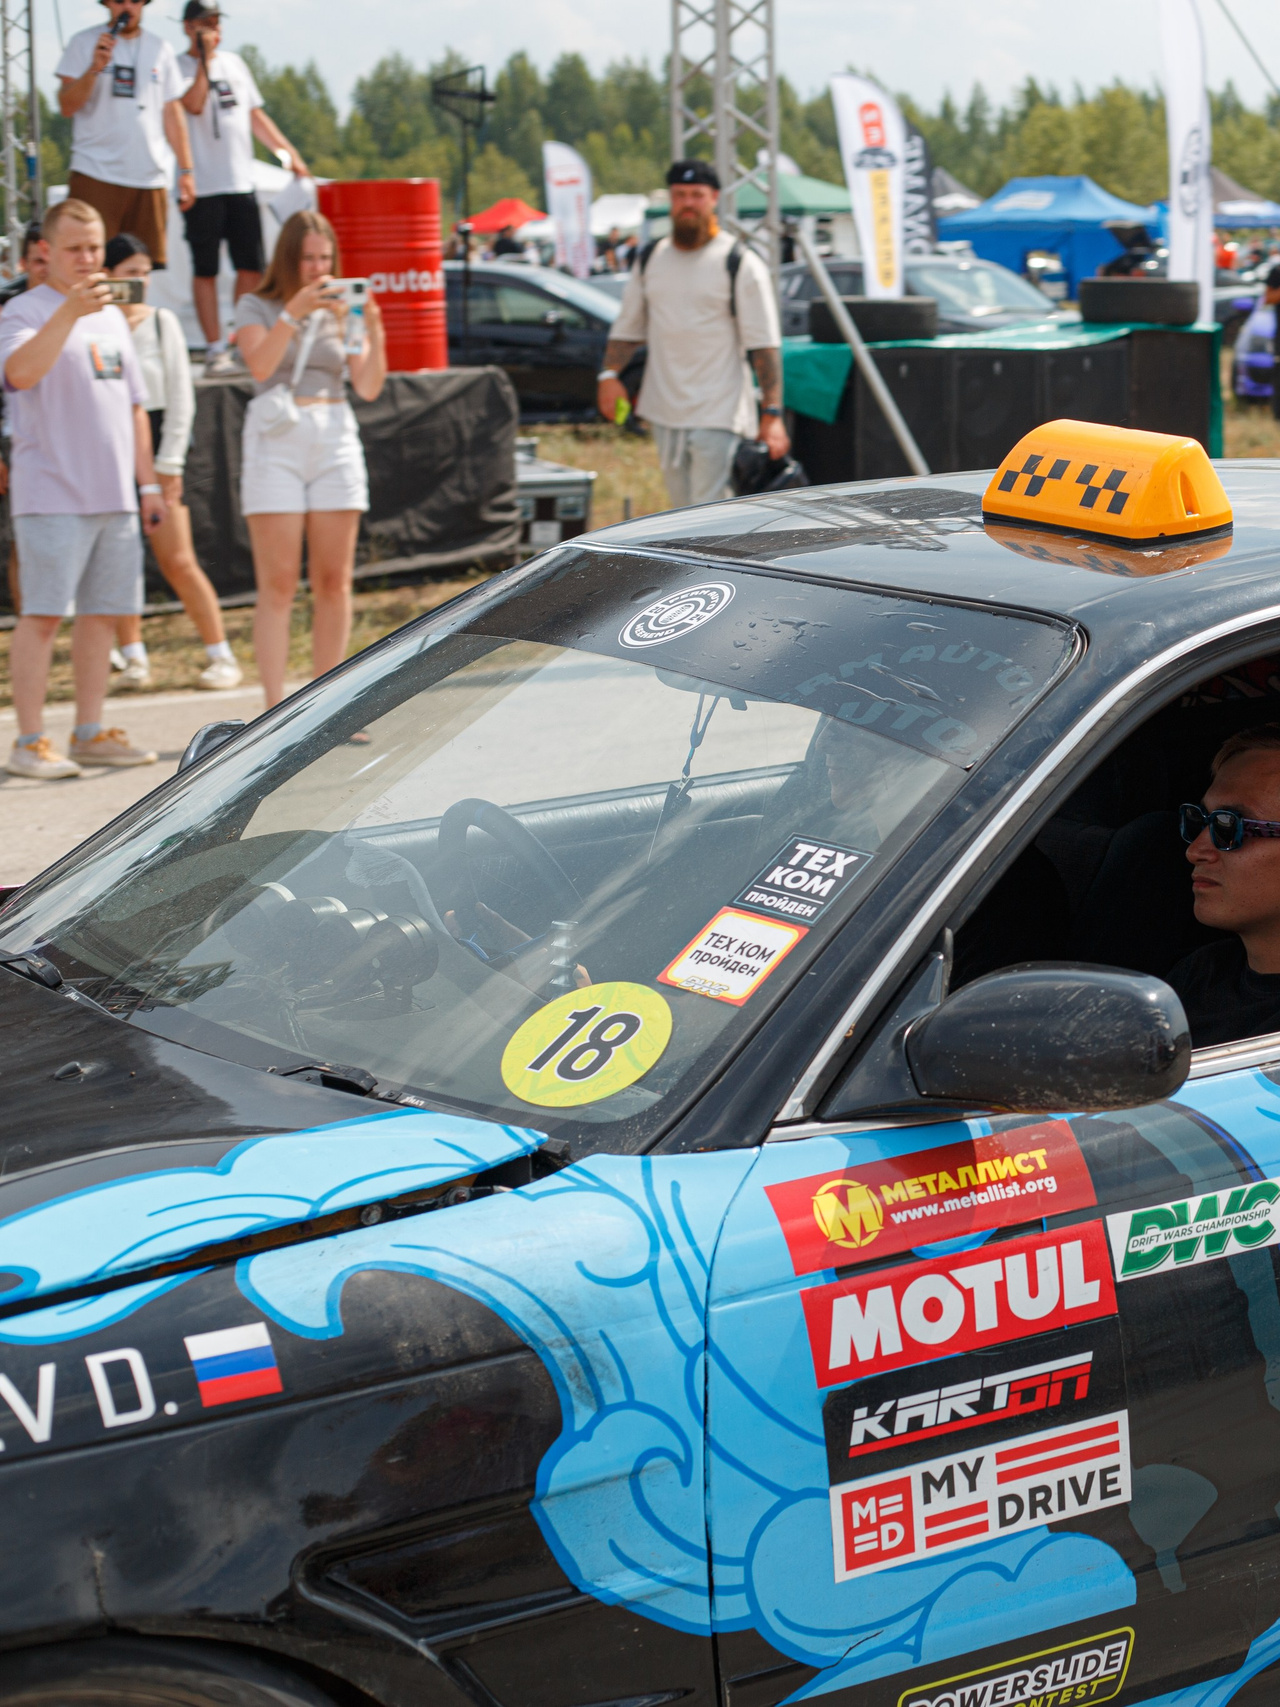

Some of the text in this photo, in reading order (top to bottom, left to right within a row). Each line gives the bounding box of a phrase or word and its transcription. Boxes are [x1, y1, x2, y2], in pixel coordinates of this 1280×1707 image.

[765, 865, 836, 897] КОМ
[789, 843, 858, 877] ТЕХ
[745, 891, 817, 917] ПРОЙДЕН
[689, 949, 761, 978] пройден
[704, 932, 776, 963] ТЕХ КОМ
[527, 1005, 643, 1082] 18
[880, 1148, 1047, 1206] МЕТАЛЛИСТ
[890, 1176, 1058, 1224] www.metallist.org
[1131, 1208, 1271, 1249] DRIFT WARS CHAMPIONSHIP
[828, 1238, 1101, 1371] MOTUL
[850, 1351, 1093, 1446] KARTON
[921, 1456, 985, 1506] MY
[998, 1463, 1122, 1529] DRIVE
